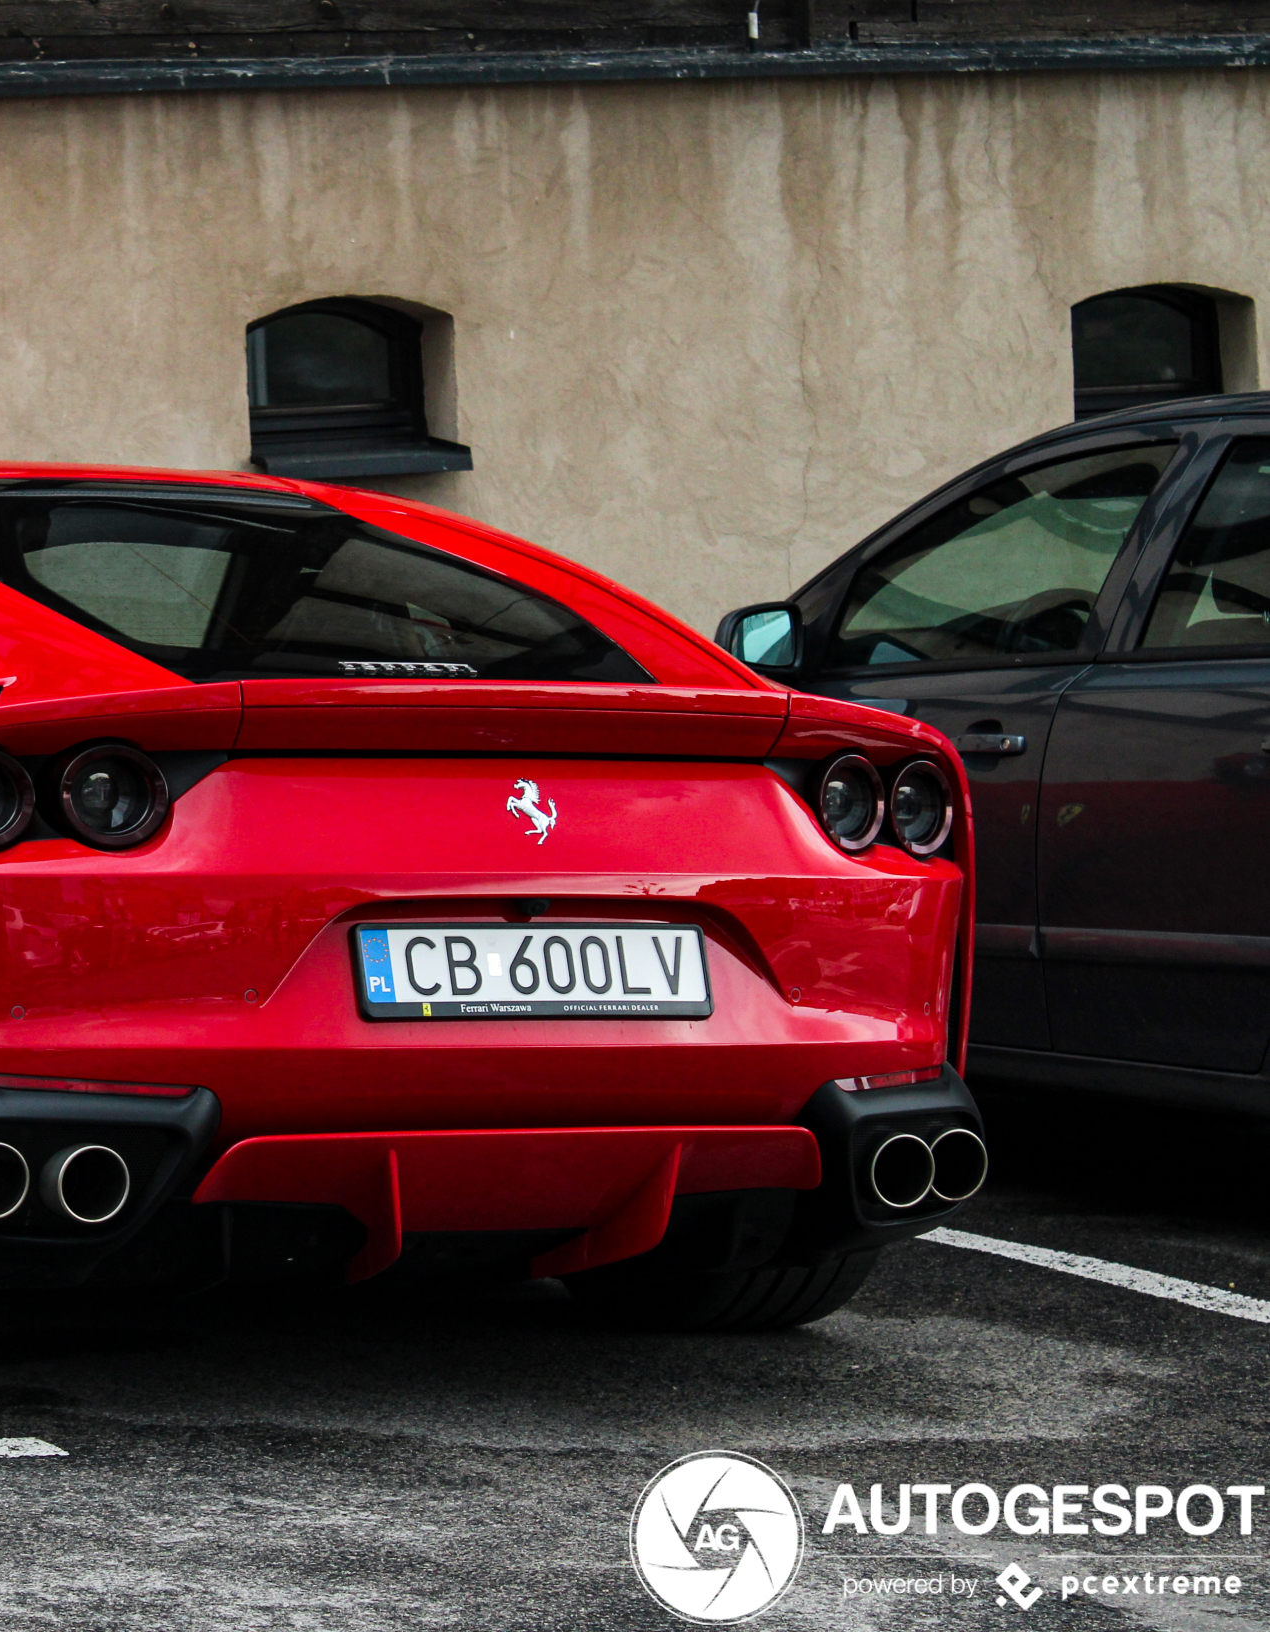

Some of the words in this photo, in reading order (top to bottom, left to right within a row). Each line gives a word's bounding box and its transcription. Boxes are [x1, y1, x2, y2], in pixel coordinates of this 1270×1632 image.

[405, 936, 483, 996] CB
[509, 936, 682, 995] 600LV
[369, 976, 391, 992] PL
[460, 1003, 488, 1013] Ferrari
[490, 1003, 532, 1013] Warszawa
